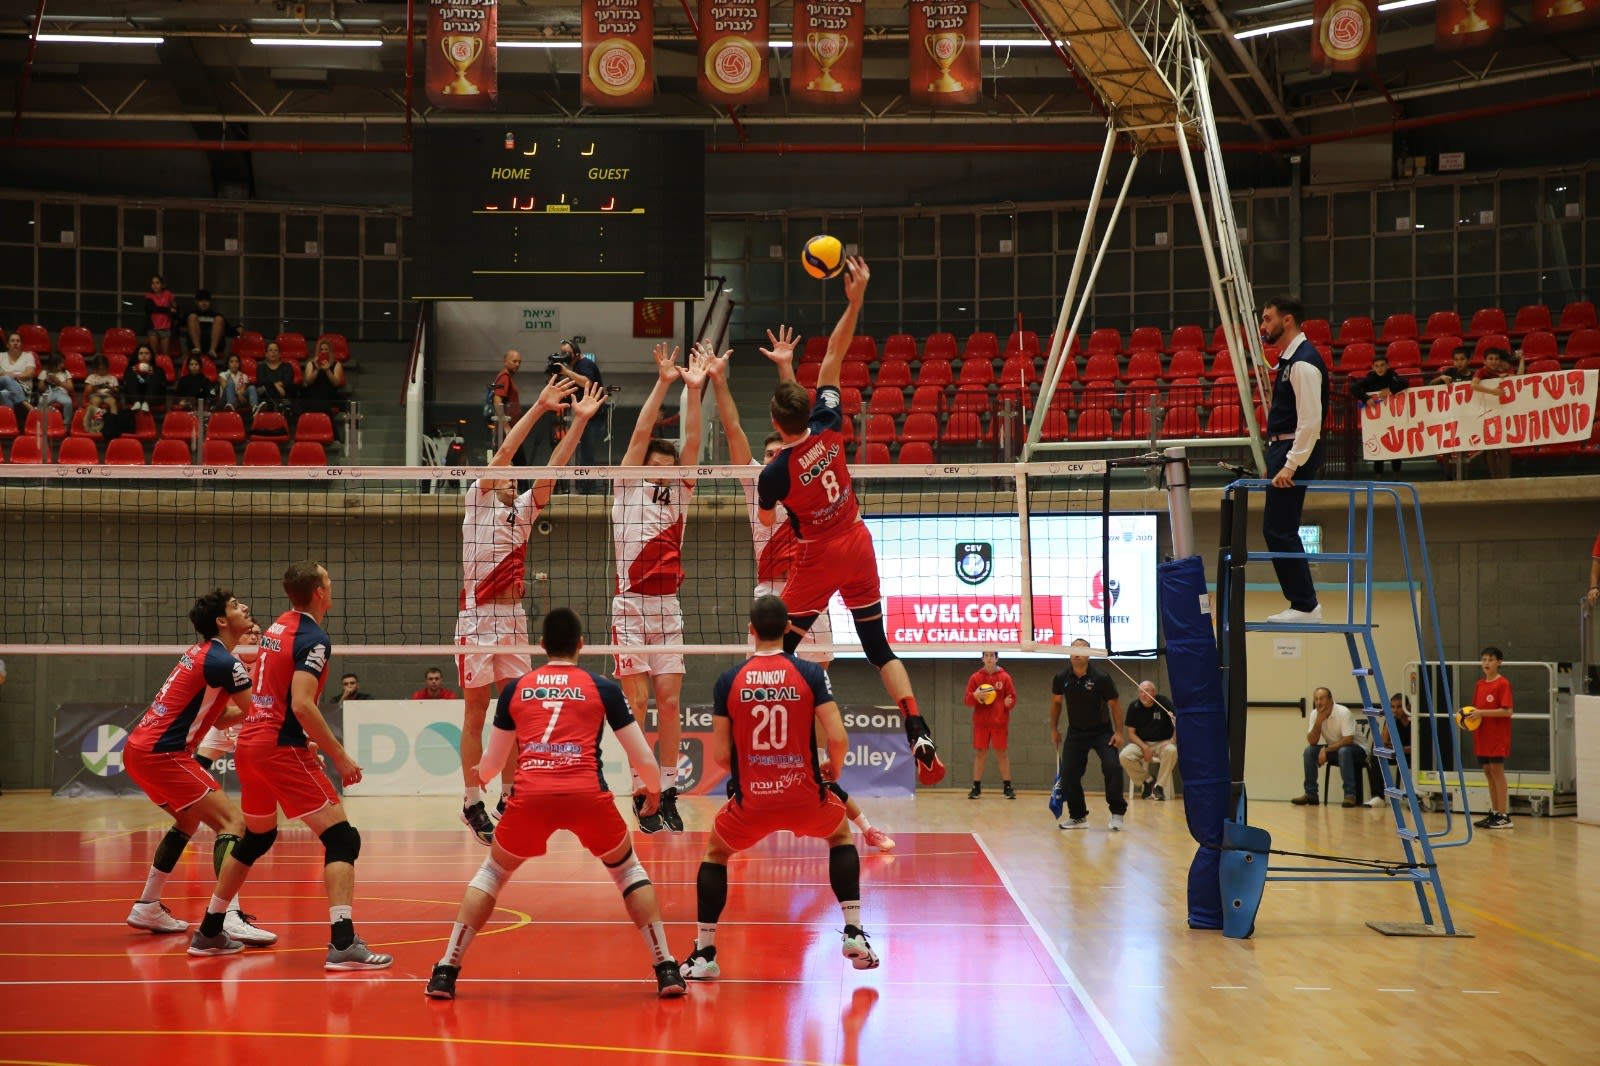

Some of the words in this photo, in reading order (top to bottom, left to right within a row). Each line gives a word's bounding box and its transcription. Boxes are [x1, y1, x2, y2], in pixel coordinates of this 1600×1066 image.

[440, 9, 485, 19] בכדורעף
[594, 10, 641, 21] בכדורעף
[711, 8, 758, 19] בכדורעף
[806, 4, 852, 16] בכדורעף
[922, 5, 968, 17] בכדורעף
[443, 21, 481, 32] לגברים
[599, 21, 637, 33] לגברים
[715, 20, 753, 31] לגברים
[810, 17, 848, 29] לגברים
[927, 16, 964, 29] לגברים
[491, 167, 531, 180] HOME
[588, 167, 629, 180] GUEST
[523, 309, 556, 318] יציאת
[525, 321, 552, 329] חרום
[798, 440, 827, 470] BANNOV
[799, 443, 840, 486] DORAL
[76, 467, 93, 475] CEV
[202, 468, 219, 476] CEV
[450, 468, 467, 476] CEV
[697, 468, 713, 476] CEV
[821, 470, 840, 503] 8
[652, 485, 672, 505] 14
[964, 544, 982, 552] CEV
[913, 603, 1020, 624] WELCOM
[1078, 615, 1089, 624] SC
[895, 628, 924, 642] CEV
[927, 628, 1019, 642] CHALLENGE
[1034, 628, 1054, 642] UP
[622, 658, 633, 669] 14
[257, 652, 267, 694] 1
[465, 672, 473, 682] 4
[745, 669, 786, 685] STANKOV
[521, 687, 586, 701] DORAL
[740, 686, 801, 702] DORAL
[541, 701, 564, 744] 7
[843, 713, 901, 728] soon
[751, 704, 788, 751] 20
[843, 745, 897, 771] olley
